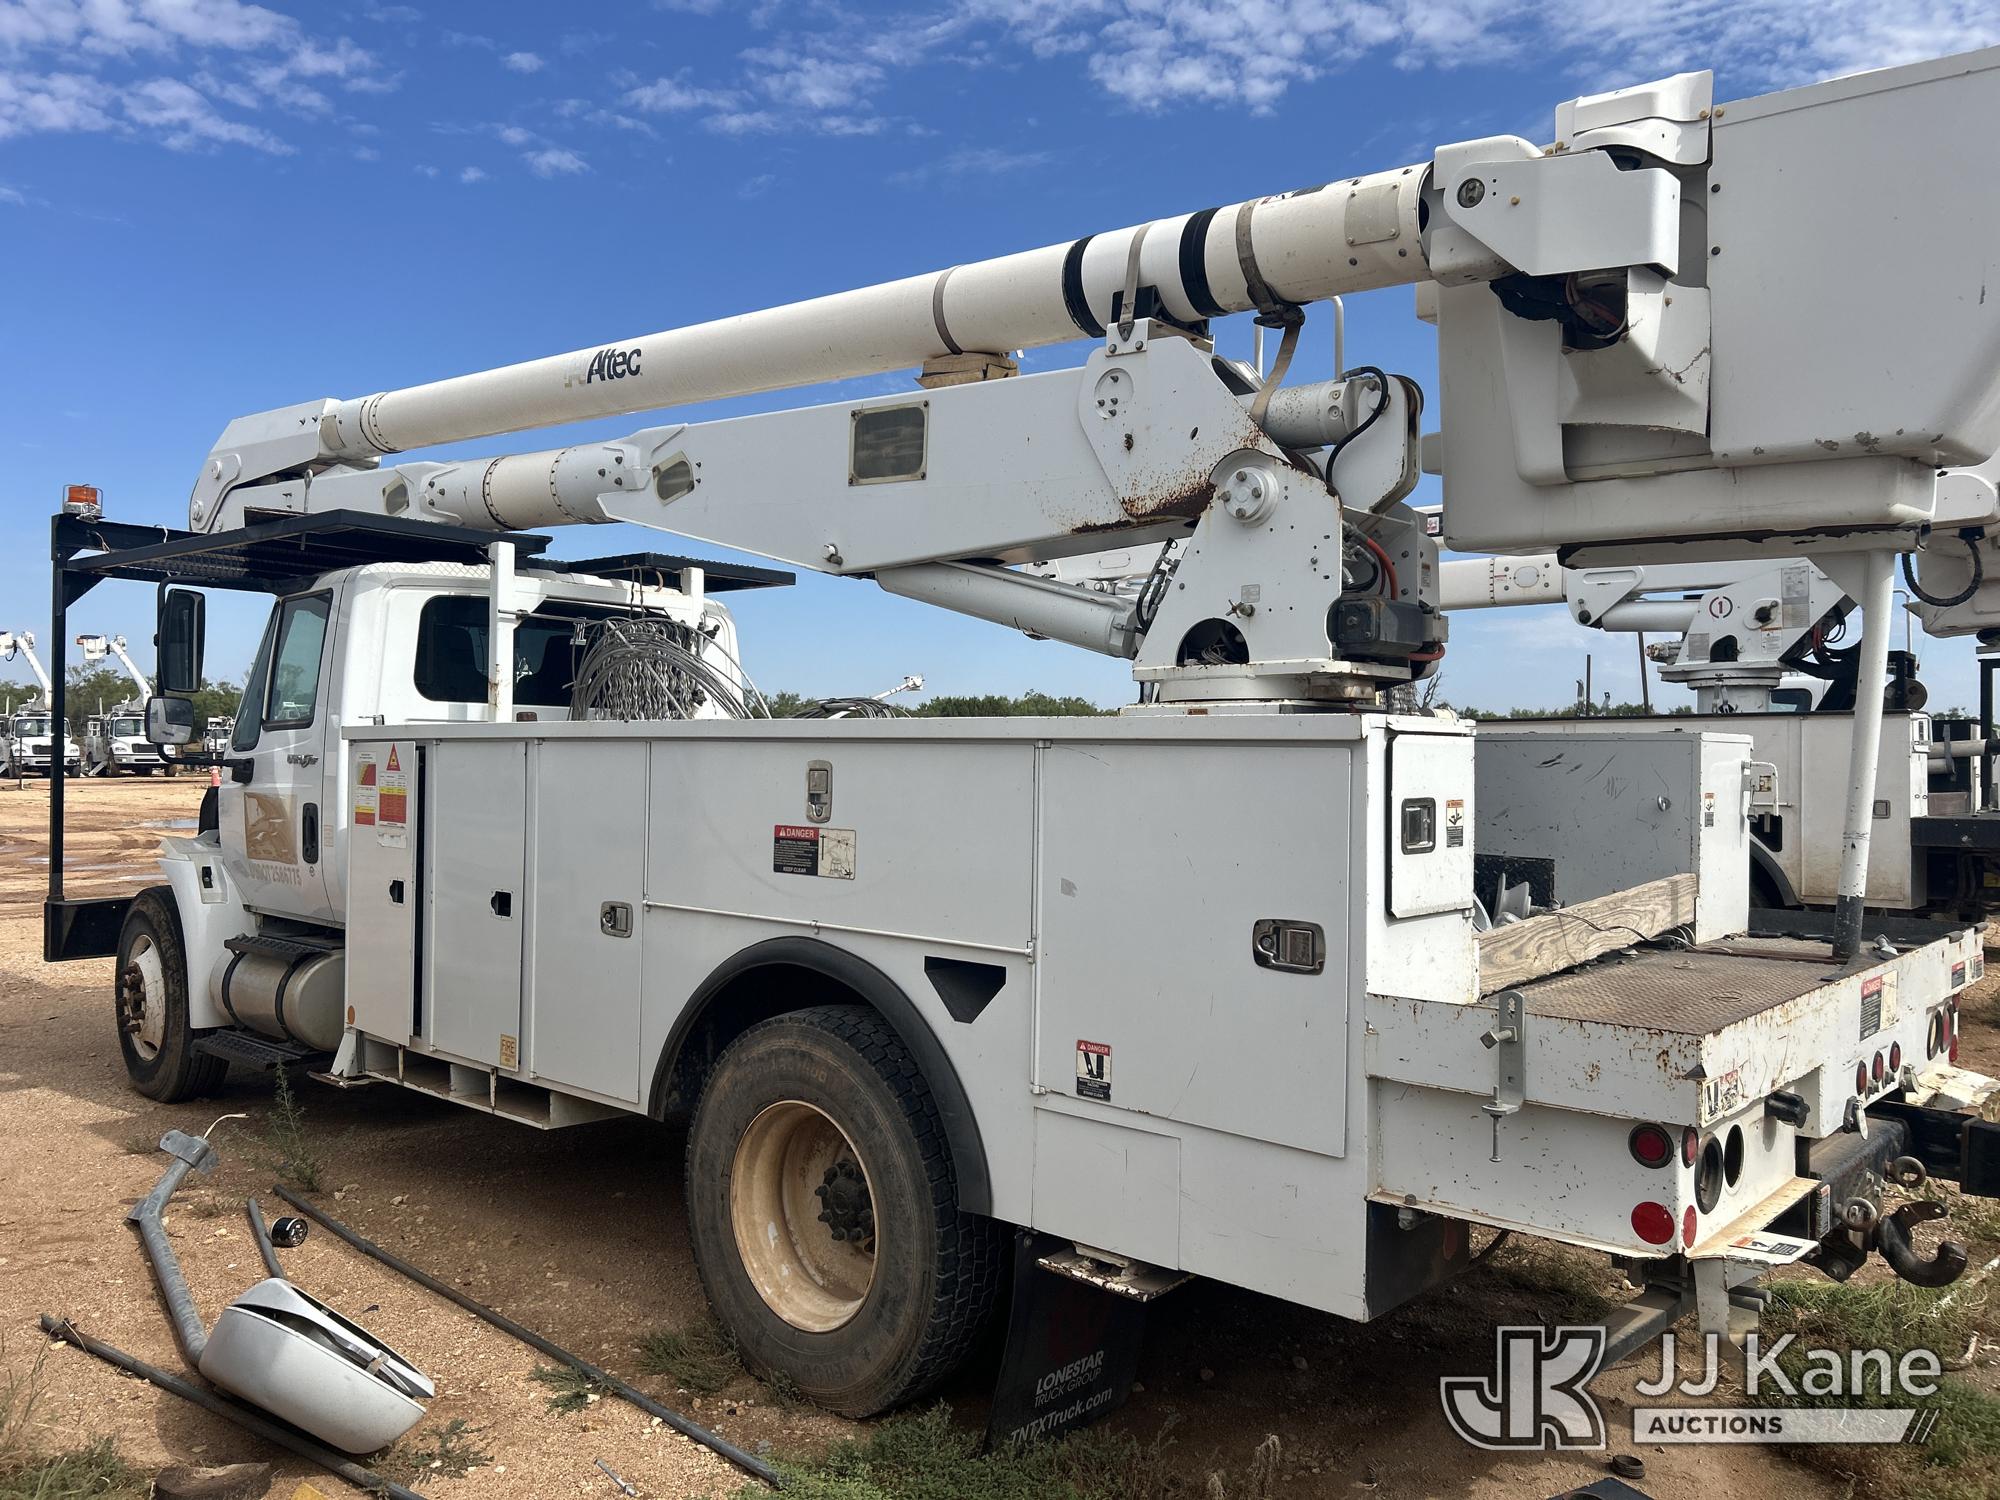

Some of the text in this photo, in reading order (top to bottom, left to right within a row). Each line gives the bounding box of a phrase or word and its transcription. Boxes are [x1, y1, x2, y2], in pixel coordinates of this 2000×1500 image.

[587, 348, 642, 384] Altec
[786, 828, 815, 838] DANGER
[1034, 1367, 1102, 1408] TRUCK GROUP
[1036, 1350, 1105, 1396] LONESTAR
[1010, 1387, 1113, 1447] TNTXTruck.com
